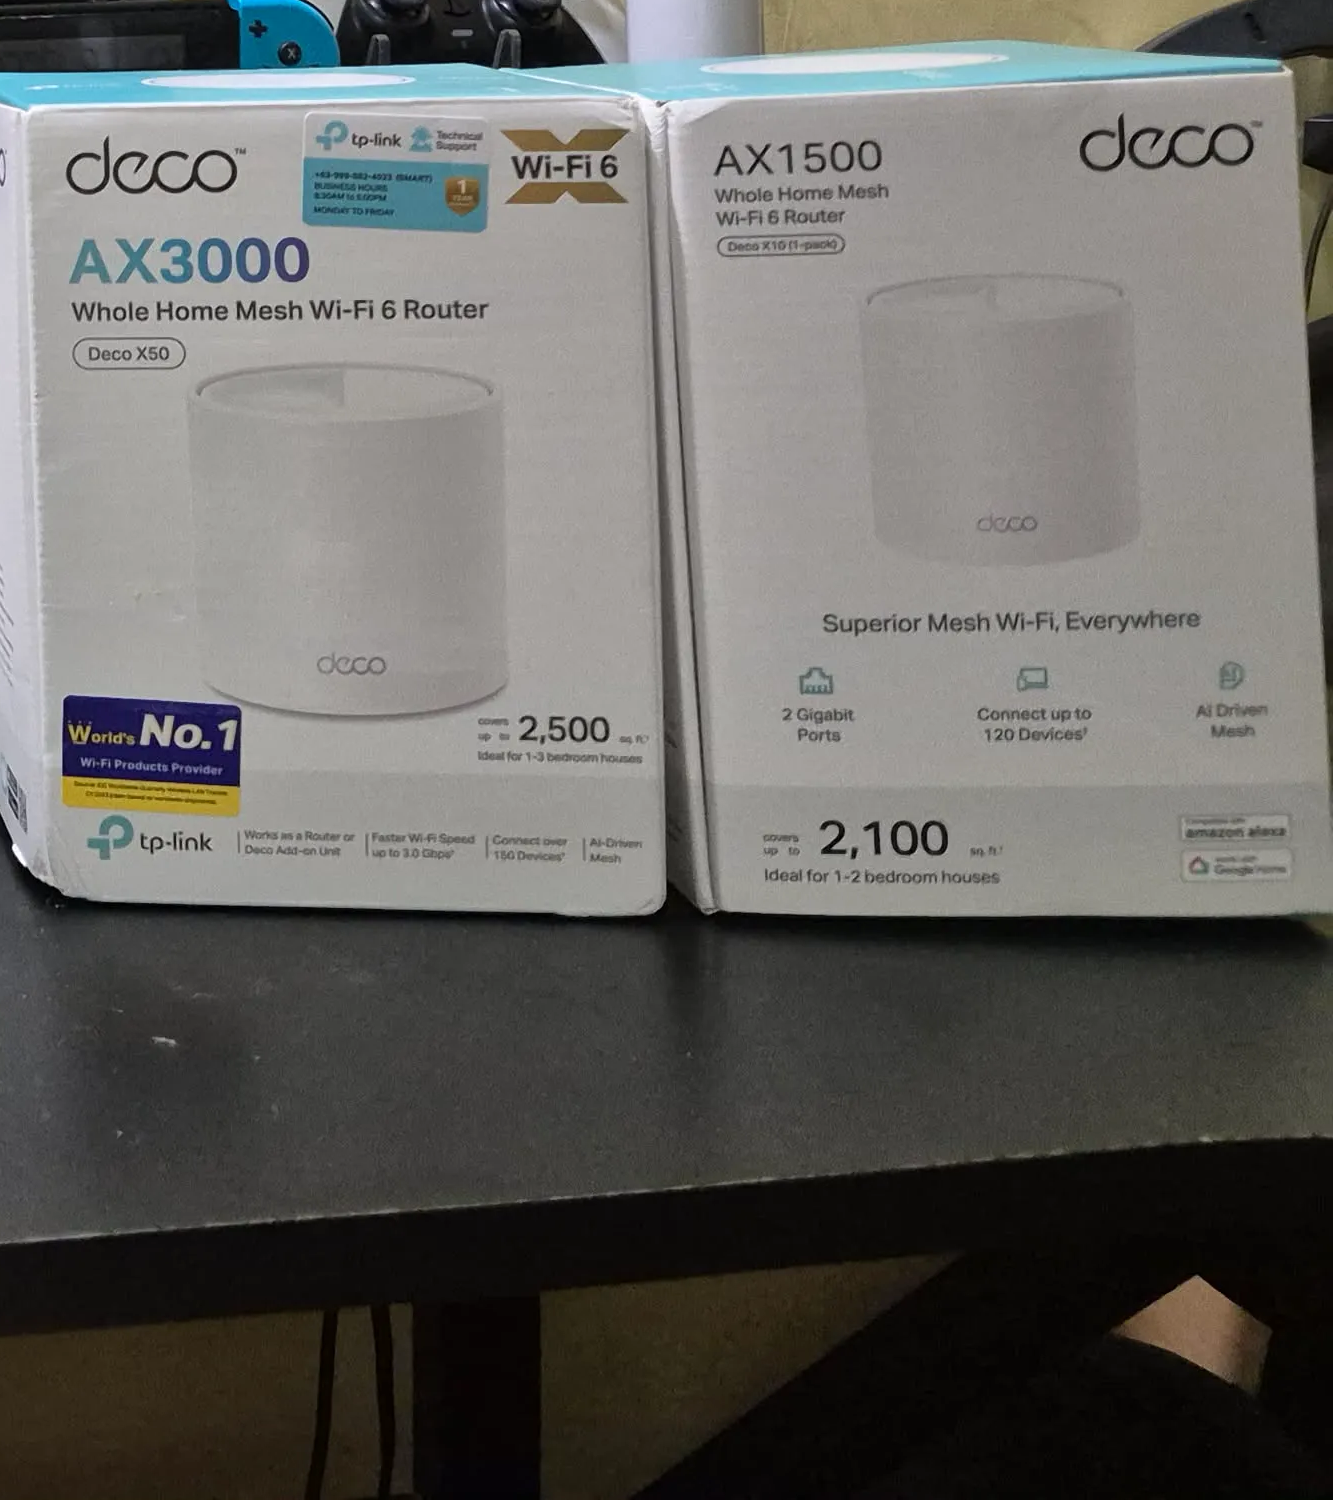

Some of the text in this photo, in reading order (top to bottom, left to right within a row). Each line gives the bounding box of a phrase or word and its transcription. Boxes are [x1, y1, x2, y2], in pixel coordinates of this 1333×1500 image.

[351, 132, 402, 149] tp-link
[436, 130, 483, 141] Technical
[436, 140, 477, 151] Support
[713, 140, 883, 176] AX1500
[511, 155, 619, 180] Wi-Fi 6
[314, 182, 388, 193] BUSINESS HOURS
[456, 179, 467, 195] 1
[715, 184, 889, 204] Whole Home Mesh
[314, 206, 395, 217] MONDAY TO FRIDAY
[716, 208, 845, 227] Wi-Fi 6 Router
[727, 242, 760, 252] Deco
[69, 237, 310, 284] AX3000
[73, 299, 490, 322] Whole Home Mesh Wi-Fi 6 Router
[88, 346, 170, 361] Deco X50
[978, 513, 1038, 533] deco
[823, 610, 1202, 637] Superior Mesh Wi-Fi, Everywhere
[317, 652, 386, 675] deco
[782, 707, 854, 724] 2 Gigabit
[977, 707, 1093, 726] Connect up to
[1196, 703, 1269, 718] AI Driven
[67, 721, 136, 745] World's
[518, 715, 611, 745] 2,500
[797, 728, 842, 742] Ports
[984, 728, 1015, 742] 120
[1211, 725, 1256, 738] Mesh
[478, 751, 643, 765] Ideal for 1-3 bedroom houses
[80, 757, 223, 776] Wi-Fi Products Provider
[140, 831, 213, 855] tp-link
[244, 829, 279, 841] Works
[281, 833, 294, 841] as
[305, 830, 341, 842] Router
[343, 833, 355, 842] or
[372, 832, 475, 847] Faster Wi-Fi Speed
[493, 834, 568, 847] Connect over
[763, 833, 800, 843] covers
[819, 819, 949, 860] 2,100
[245, 844, 341, 857] Deco Add-on Unit
[590, 837, 642, 850] AI-Driven
[372, 851, 386, 860] up
[388, 849, 400, 858] to
[402, 848, 420, 858] 3.0
[590, 853, 621, 864] Mesh
[763, 846, 800, 857] up to
[764, 868, 1001, 885] Ideal for 1-2 bedroom houses
